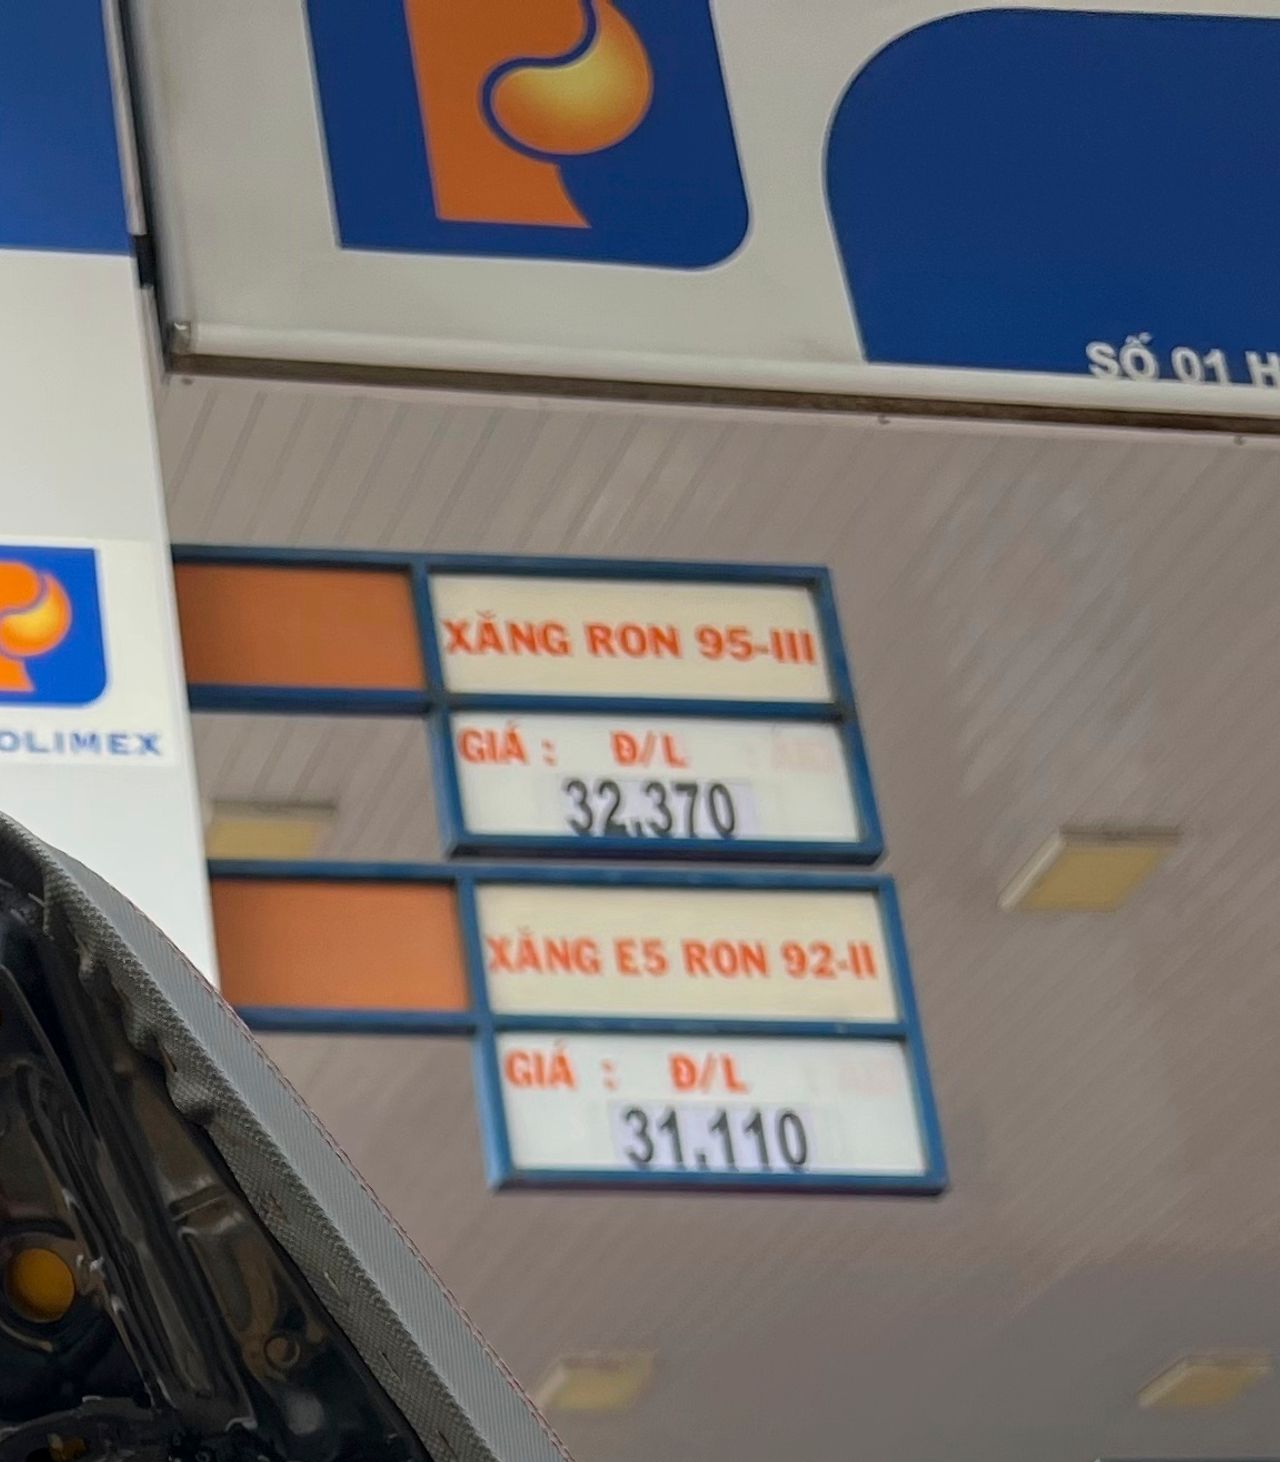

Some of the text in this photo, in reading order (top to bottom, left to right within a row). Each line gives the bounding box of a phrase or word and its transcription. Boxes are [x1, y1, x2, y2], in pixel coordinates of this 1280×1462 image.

[1170, 347, 1228, 384] 01
[443, 610, 816, 664] XĂNG RON 95-III
[458, 721, 528, 764] GIÁ
[487, 927, 877, 980] XĂNG E5 RON 92-II
[505, 1040, 576, 1089] GIÁ
[623, 1107, 810, 1172] 31.110
